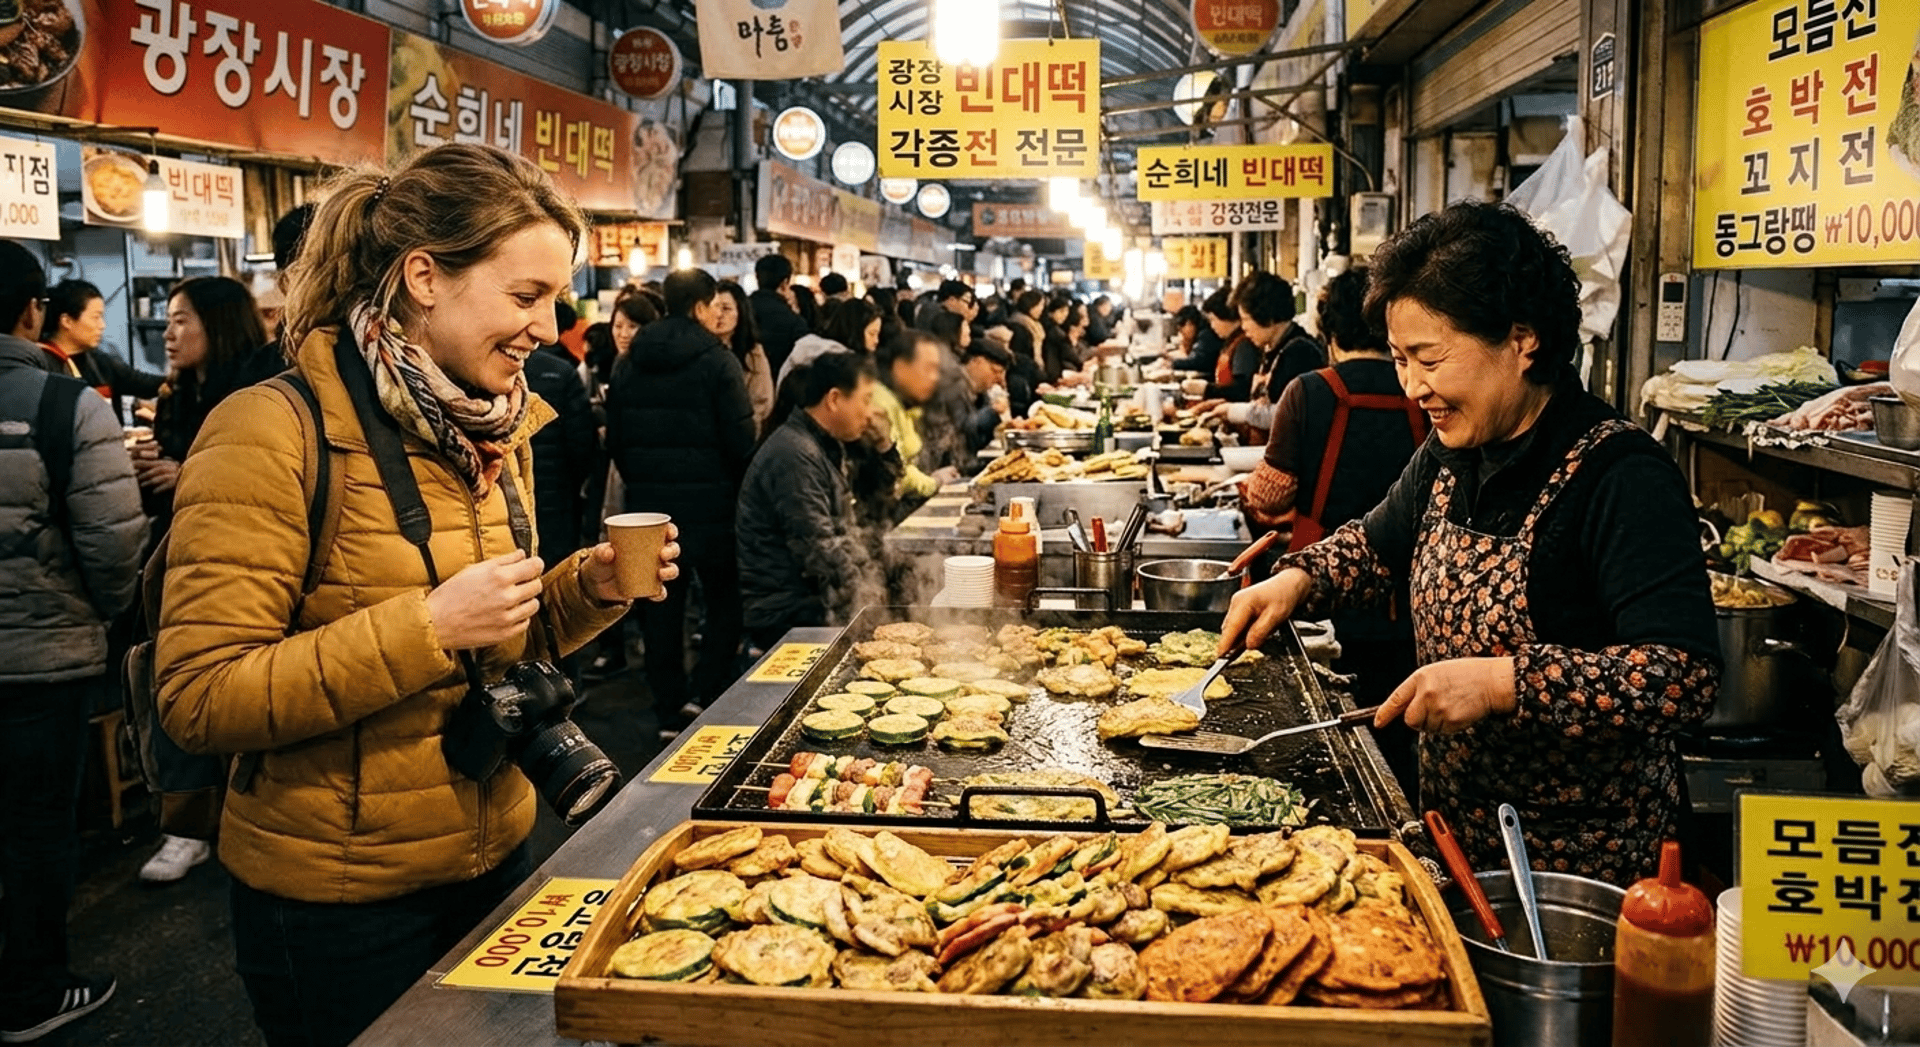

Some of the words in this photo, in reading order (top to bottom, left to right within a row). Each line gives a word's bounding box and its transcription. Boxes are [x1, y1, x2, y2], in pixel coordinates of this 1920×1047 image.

[131, 0, 365, 129] 광장시장
[889, 59, 943, 85] 광장
[955, 60, 1086, 113] 빈대떡
[1743, 53, 1878, 136] 호박전
[410, 74, 523, 155] 순희네
[889, 89, 943, 115] 시장
[890, 128, 997, 168] 각종전
[1015, 128, 1087, 167] 전문
[1145, 158, 1227, 188] 순희네
[1243, 156, 1323, 187] 빈대떡
[1741, 127, 1874, 195] 꼬지전
[475, 893, 574, 968] ₩10,000
